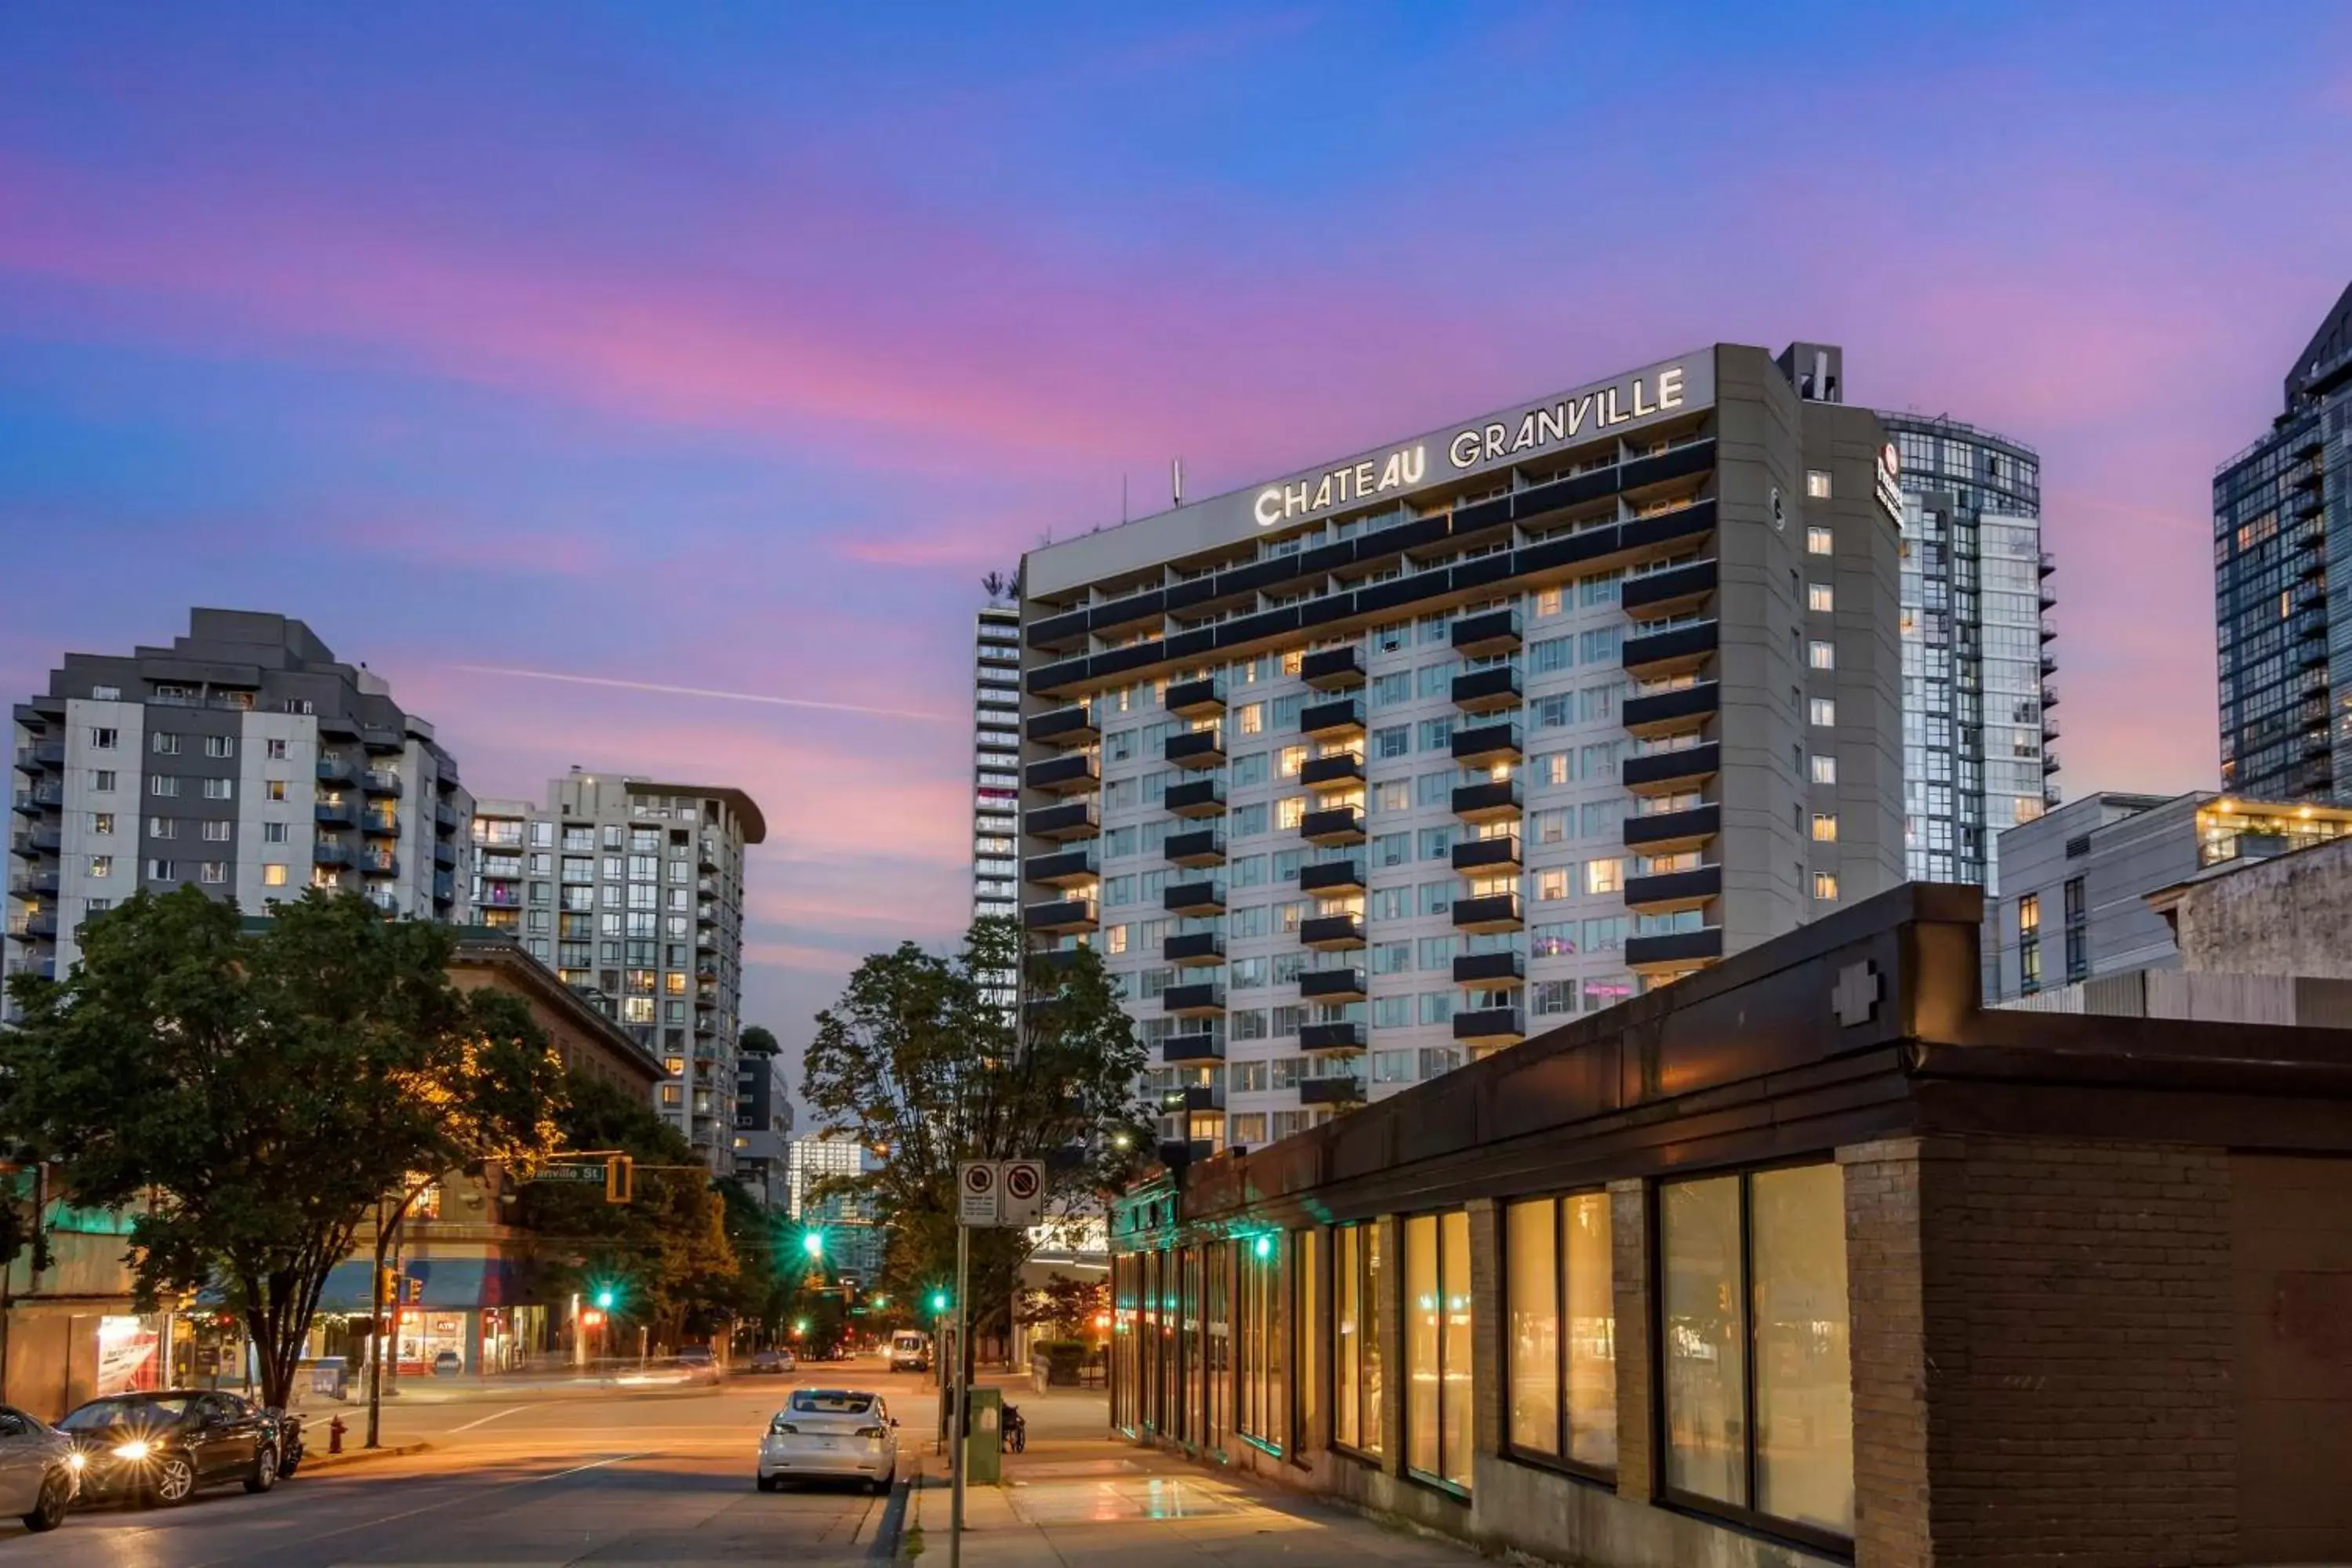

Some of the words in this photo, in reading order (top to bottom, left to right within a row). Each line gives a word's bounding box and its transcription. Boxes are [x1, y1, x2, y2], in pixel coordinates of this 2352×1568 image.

[1254, 445, 1425, 527] CHATEAU
[1448, 366, 1684, 470] GRANVILLE
[536, 1166, 578, 1178] anville
[583, 1167, 598, 1178] St
